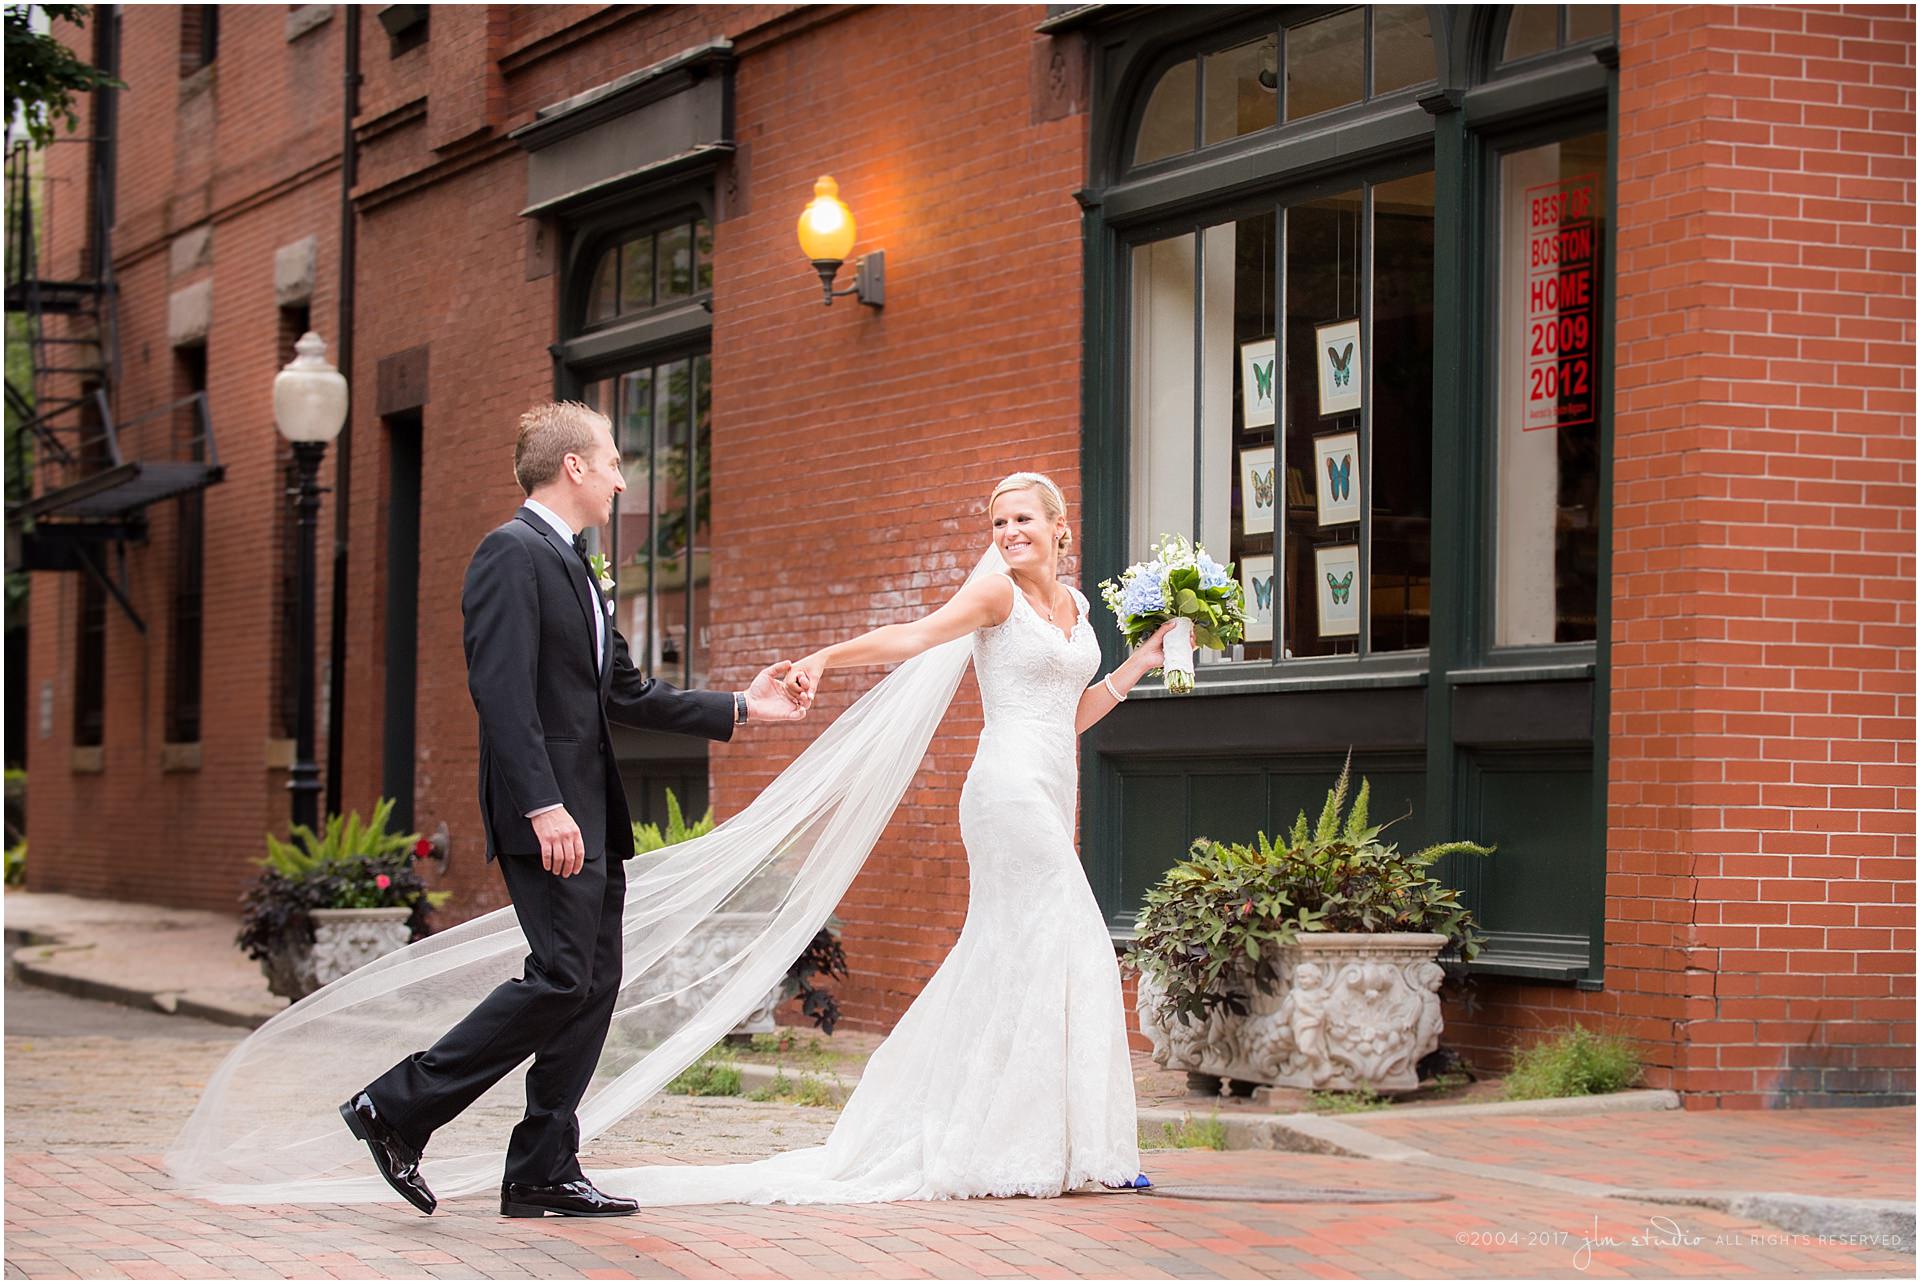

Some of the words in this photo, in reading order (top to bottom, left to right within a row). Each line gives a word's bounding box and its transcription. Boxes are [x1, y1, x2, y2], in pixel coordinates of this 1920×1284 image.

[1532, 192, 1567, 227] BEST
[1571, 187, 1591, 218] OF
[1532, 228, 1590, 267] BOSTON
[1531, 271, 1589, 313] HOME
[1531, 315, 1588, 356] 2009
[1530, 360, 1588, 401] 2012
